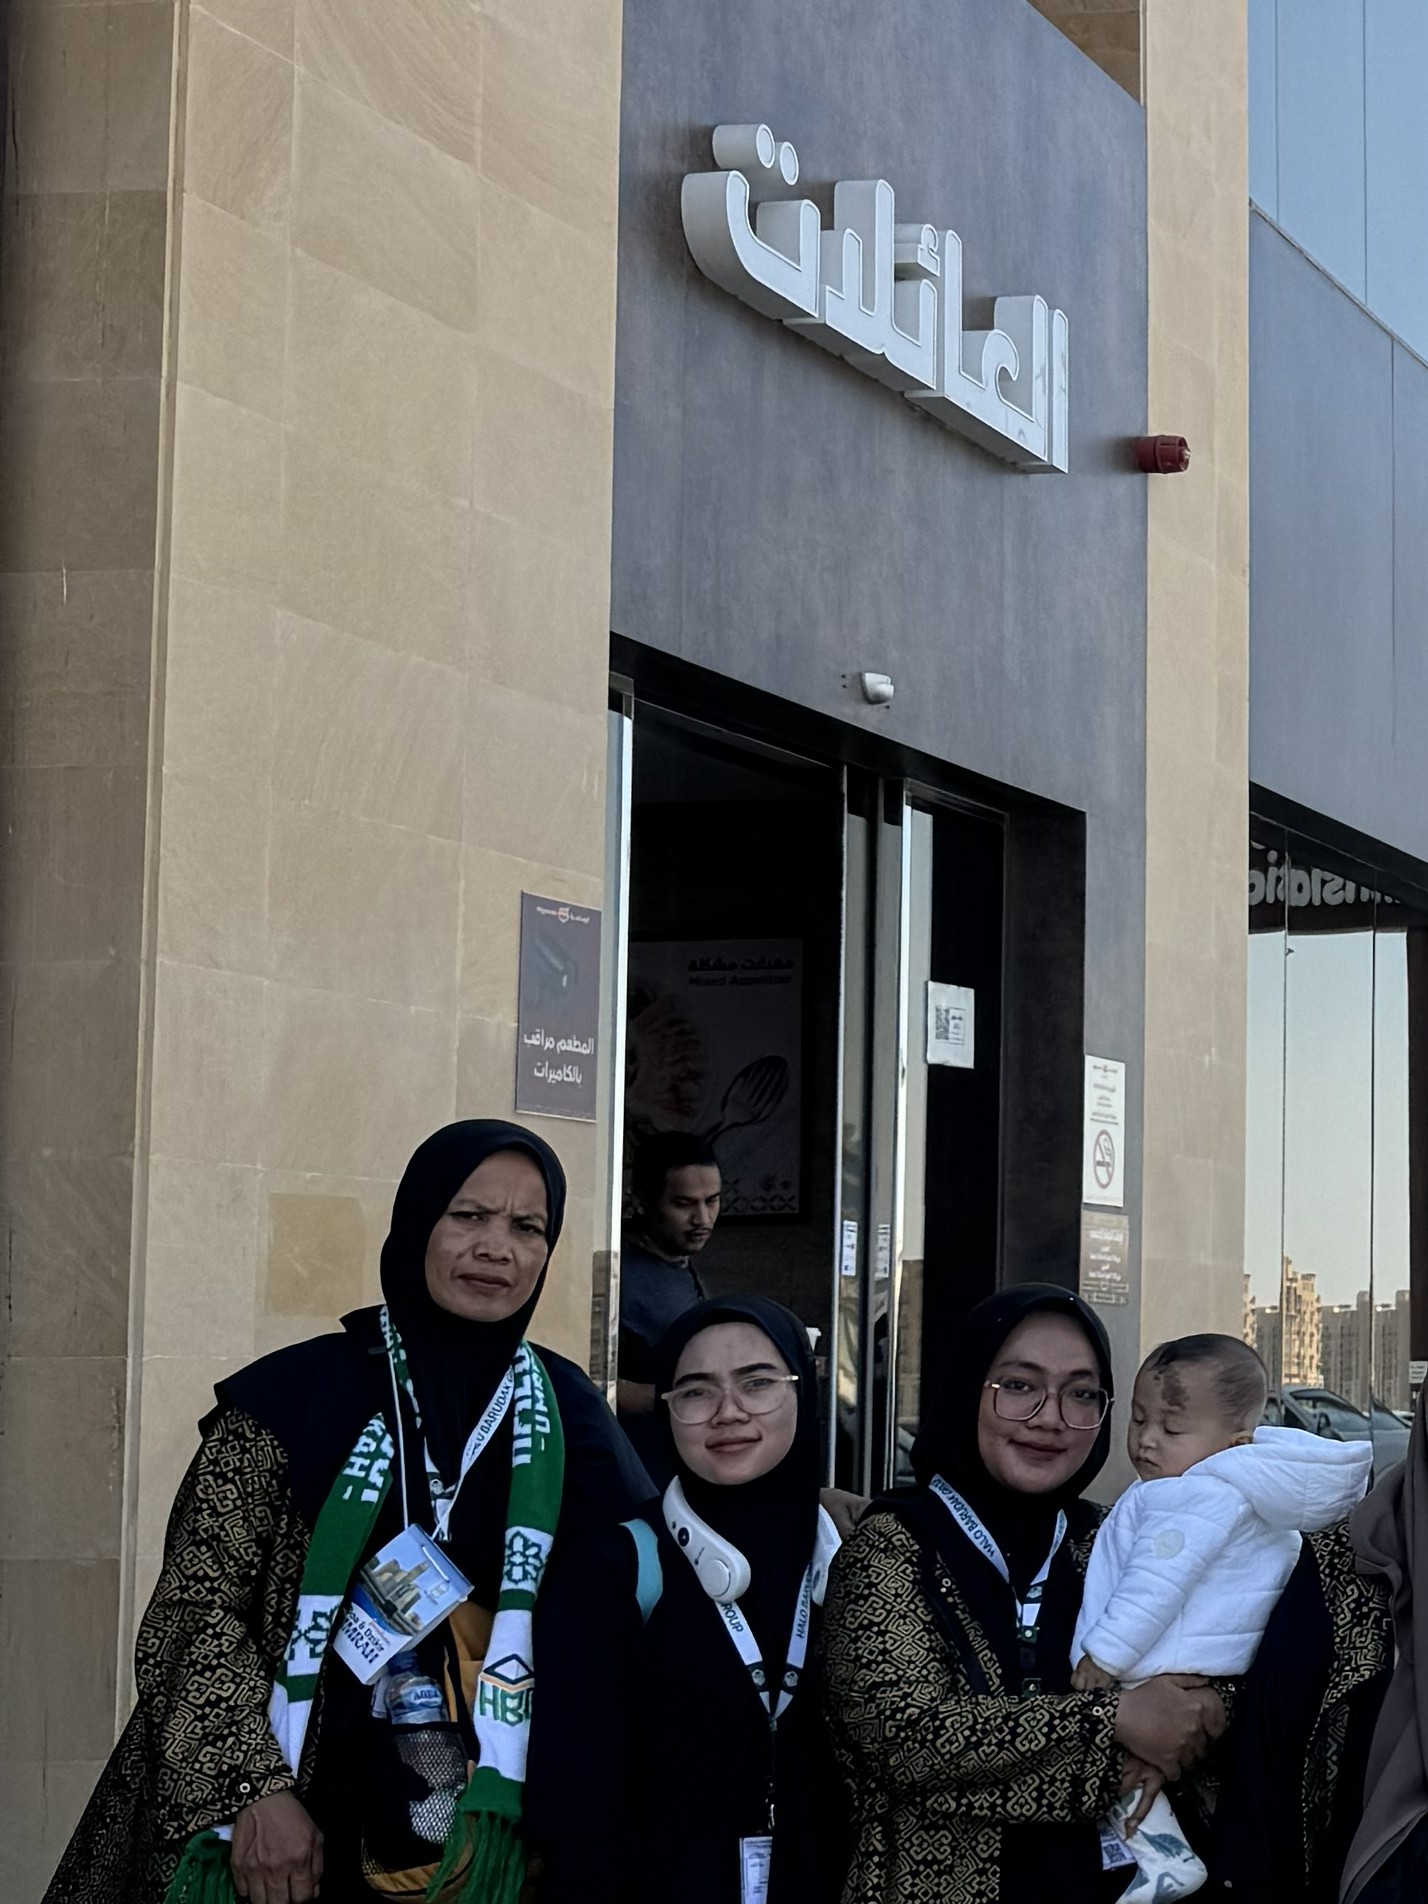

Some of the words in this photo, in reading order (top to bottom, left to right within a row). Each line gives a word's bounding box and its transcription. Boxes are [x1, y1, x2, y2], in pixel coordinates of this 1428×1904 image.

[523, 1028, 556, 1051] مراقب
[556, 1034, 595, 1055] المطعم
[972, 1529, 997, 1558] HALO
